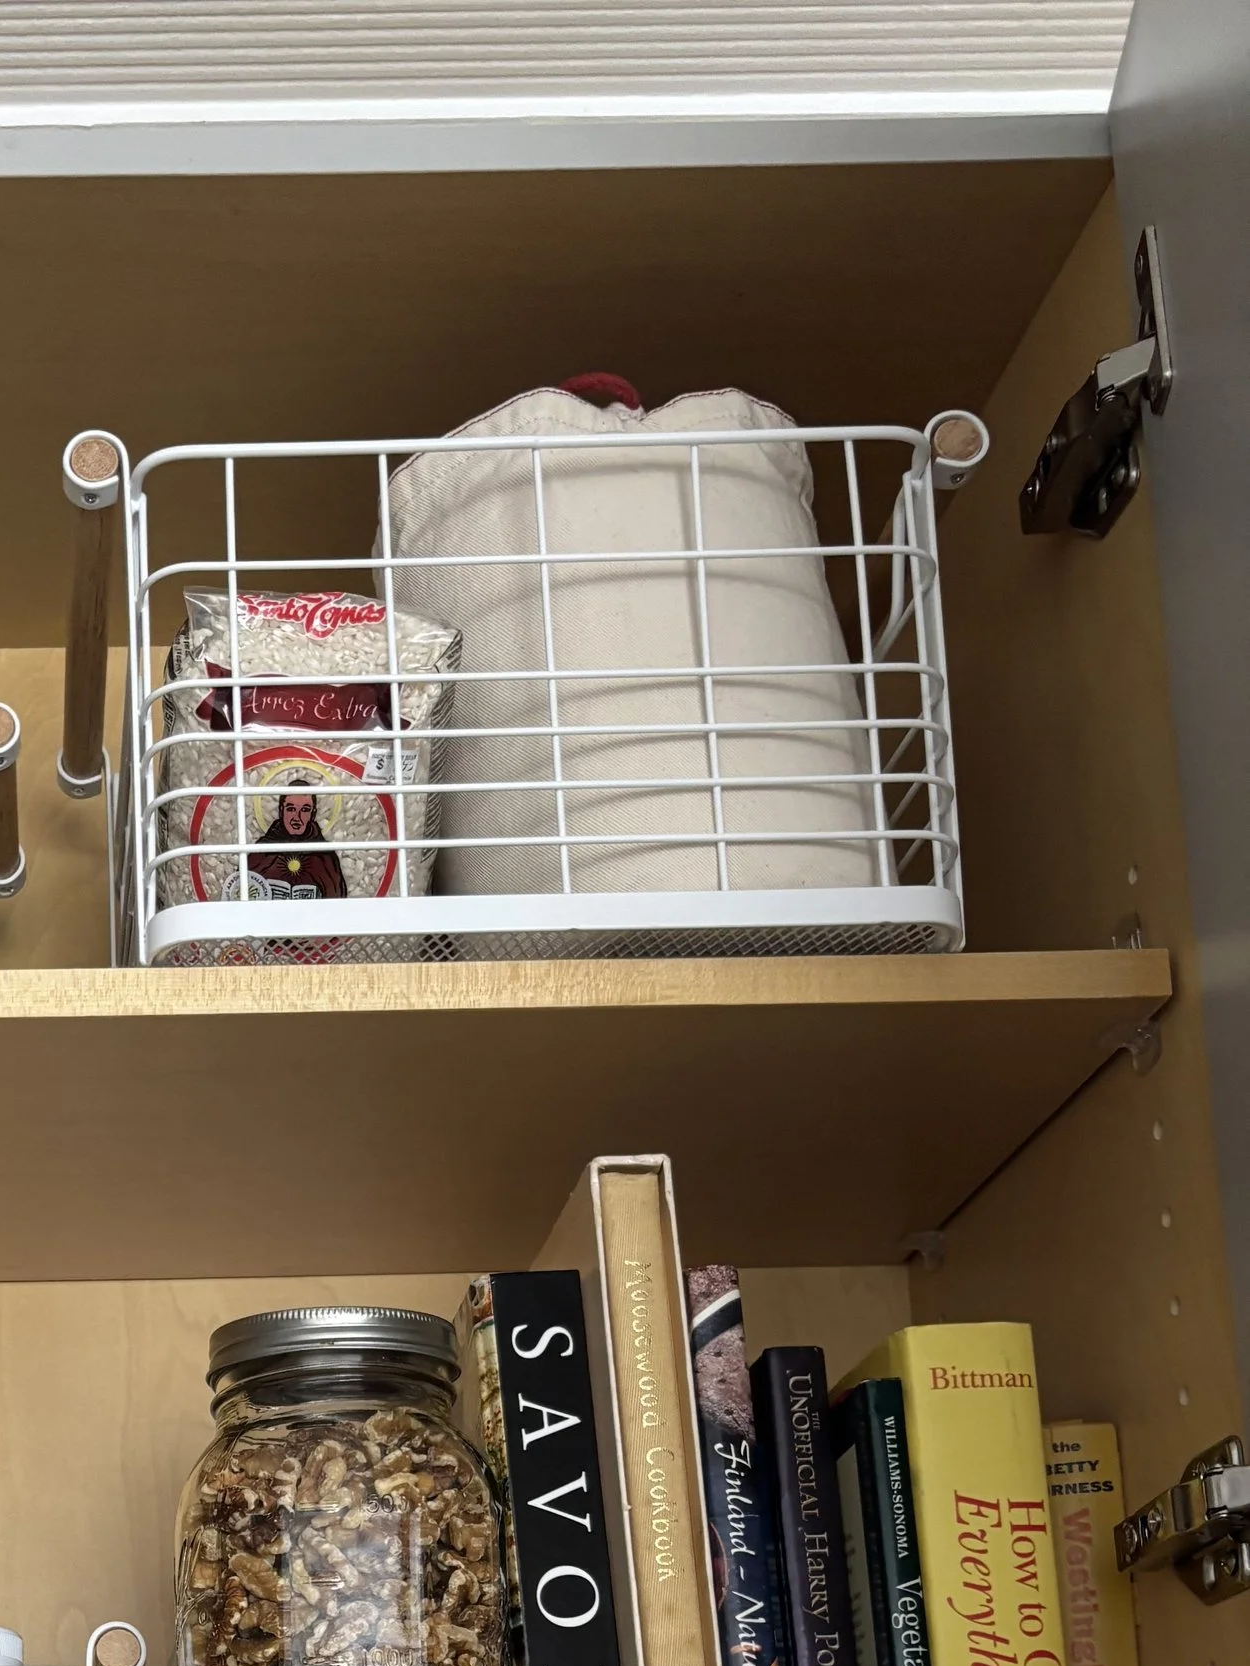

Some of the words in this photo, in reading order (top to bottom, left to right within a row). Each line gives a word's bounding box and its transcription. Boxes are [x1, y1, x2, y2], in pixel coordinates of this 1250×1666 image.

[244, 685, 304, 719] Arroz
[314, 693, 378, 720] Extra
[624, 1259, 667, 1429] Moosewood
[930, 1366, 1034, 1390] Bittman
[788, 1373, 819, 1519] UNOFFICIAL
[1052, 1441, 1081, 1453] the
[645, 1447, 686, 1583] Cookbook
[714, 1440, 756, 1556] Finland
[1007, 1499, 1048, 1592] How
[1018, 1603, 1047, 1637] to
